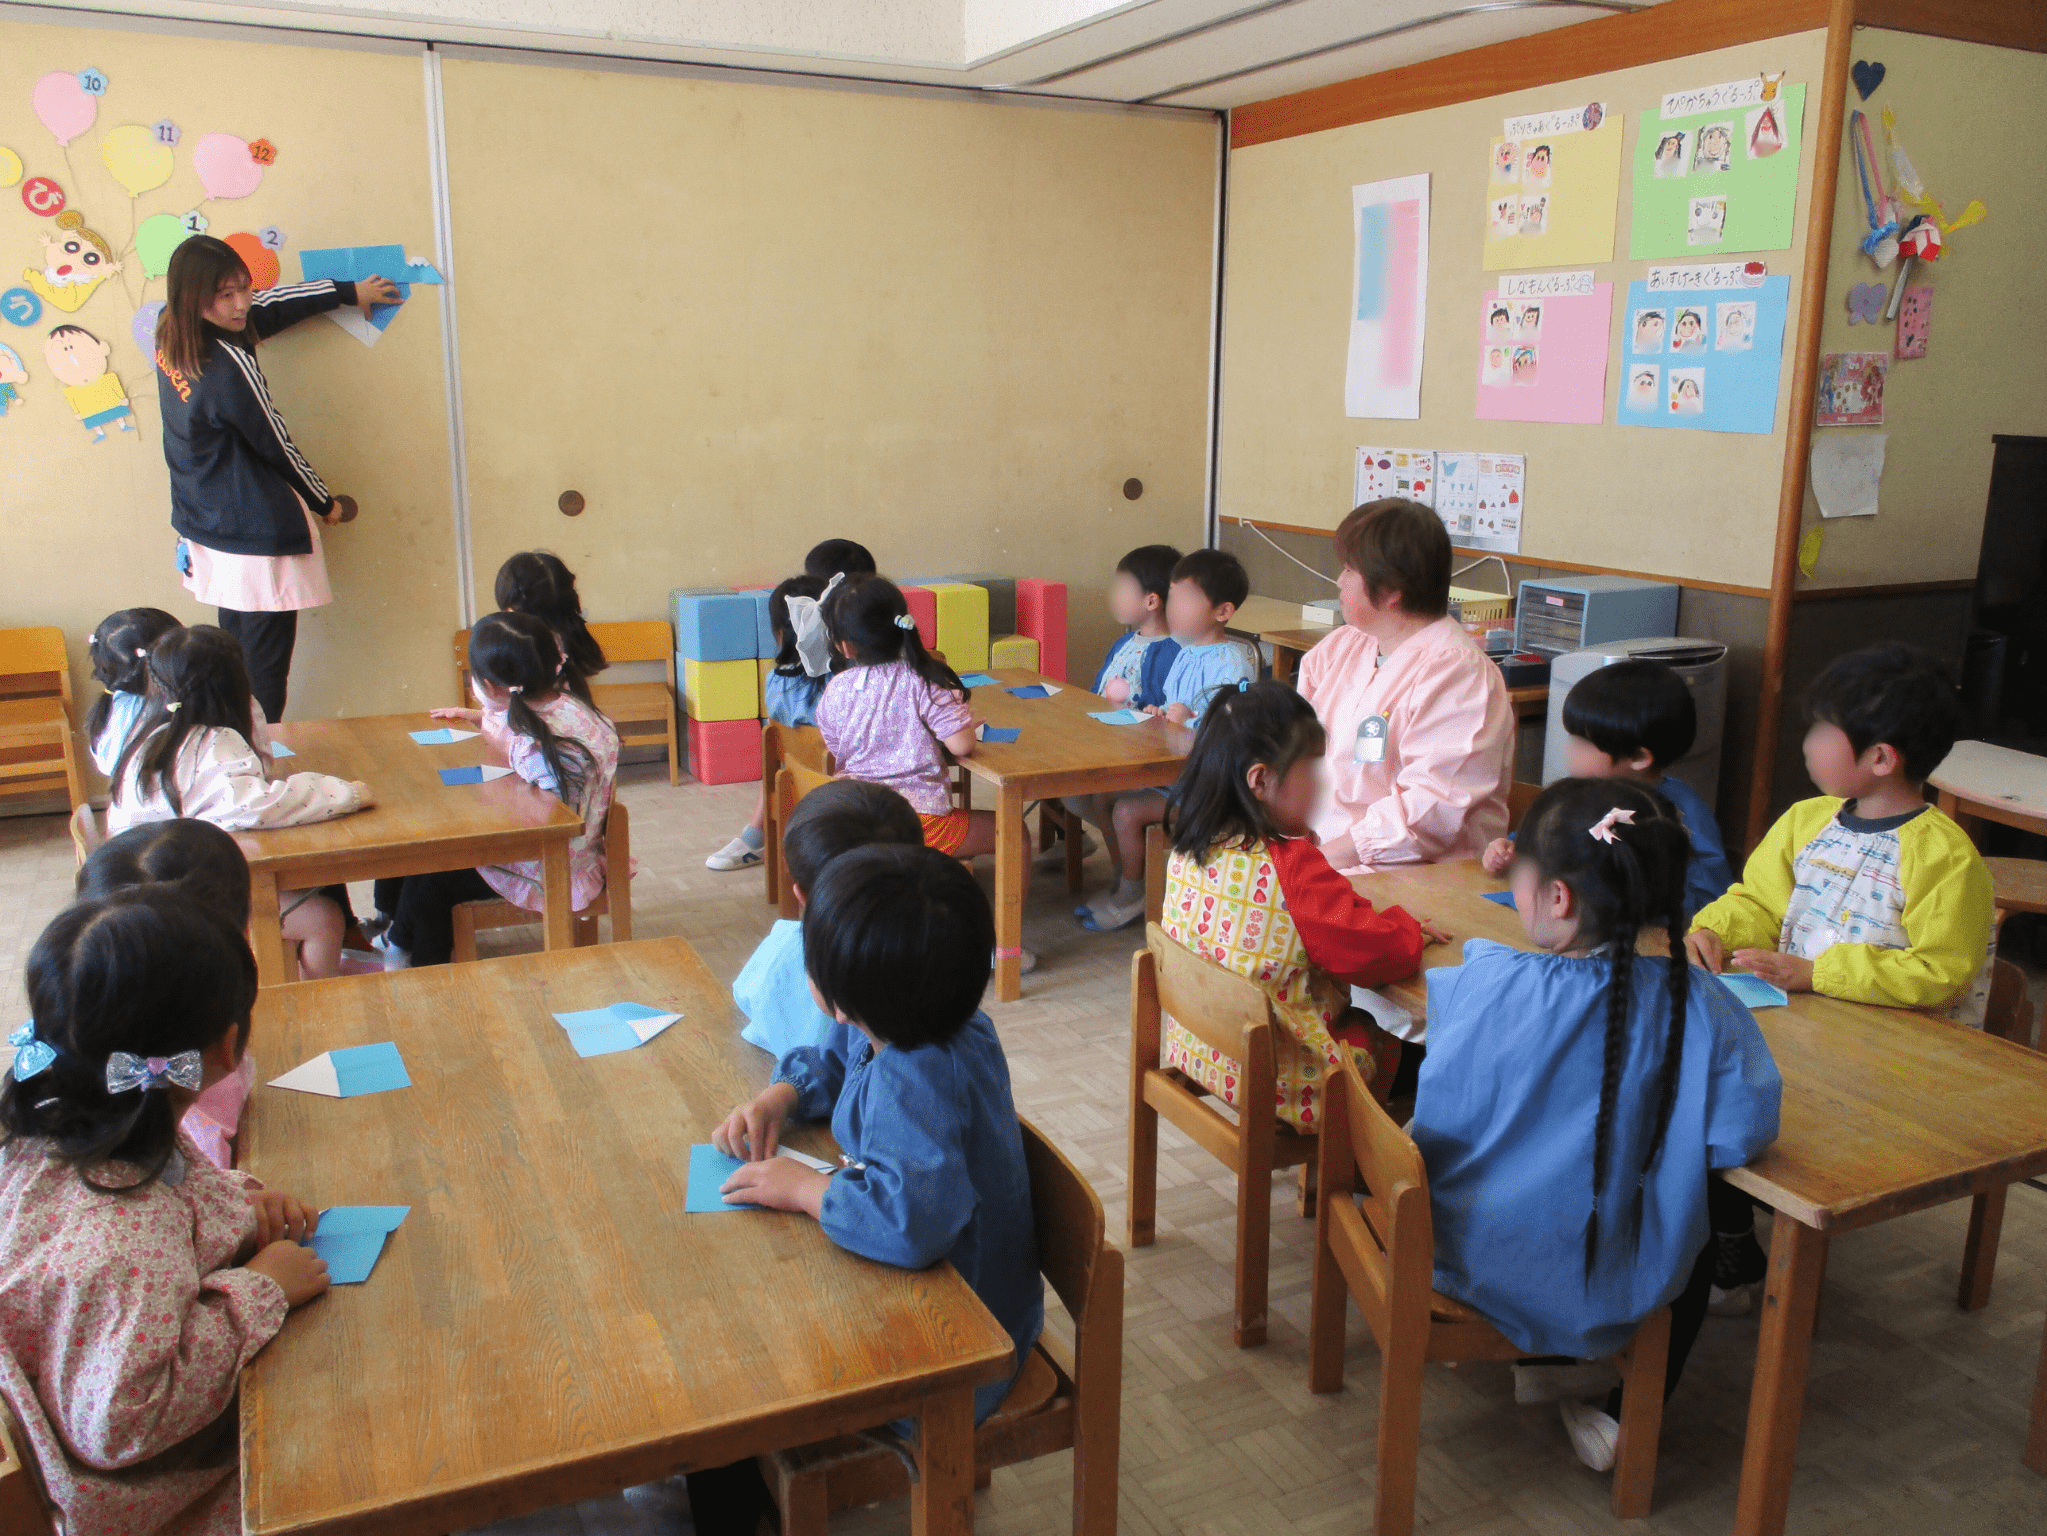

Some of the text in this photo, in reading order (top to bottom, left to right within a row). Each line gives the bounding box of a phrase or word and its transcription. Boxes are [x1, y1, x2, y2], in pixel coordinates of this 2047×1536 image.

[83, 74, 101, 92] 10
[158, 124, 174, 143] 11
[253, 145, 270, 162] 12
[186, 215, 202, 232] 1
[266, 230, 279, 246] 2
[1507, 274, 1576, 296] しなもんぐるーぷ
[9, 295, 33, 321] う
